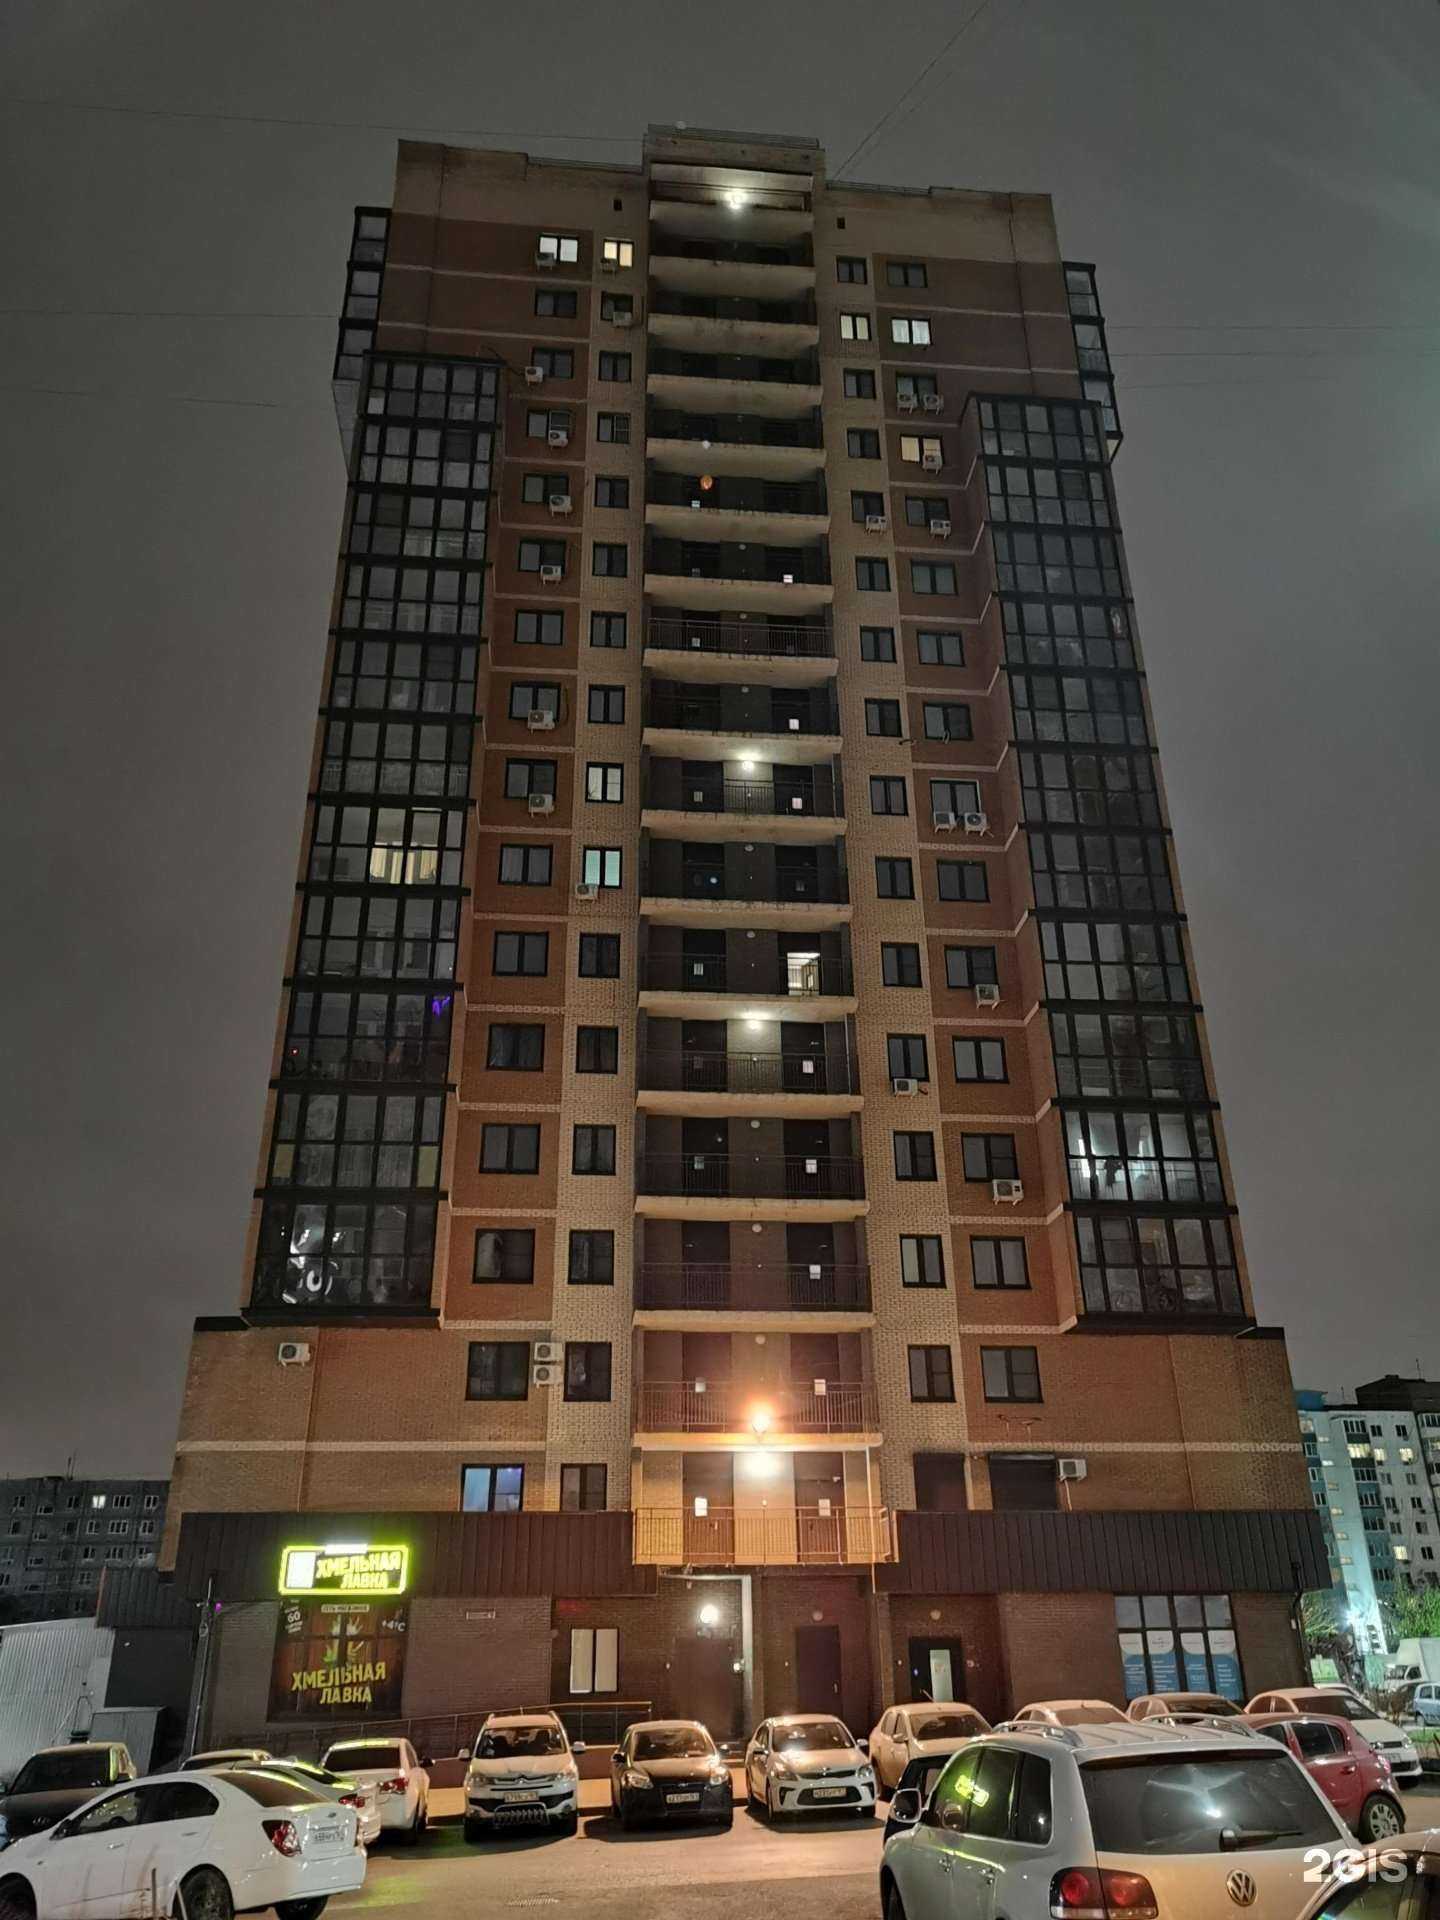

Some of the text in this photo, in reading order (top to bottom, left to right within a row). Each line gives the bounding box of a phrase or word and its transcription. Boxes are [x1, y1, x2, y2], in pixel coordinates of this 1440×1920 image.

[316, 1551, 401, 1578] ХМЕЛЬНАЯ
[340, 1572, 388, 1589] ЛАВКА
[291, 1661, 387, 1692] ХМЕЛЬНАЯ
[319, 1686, 373, 1705] ЛАВКА
